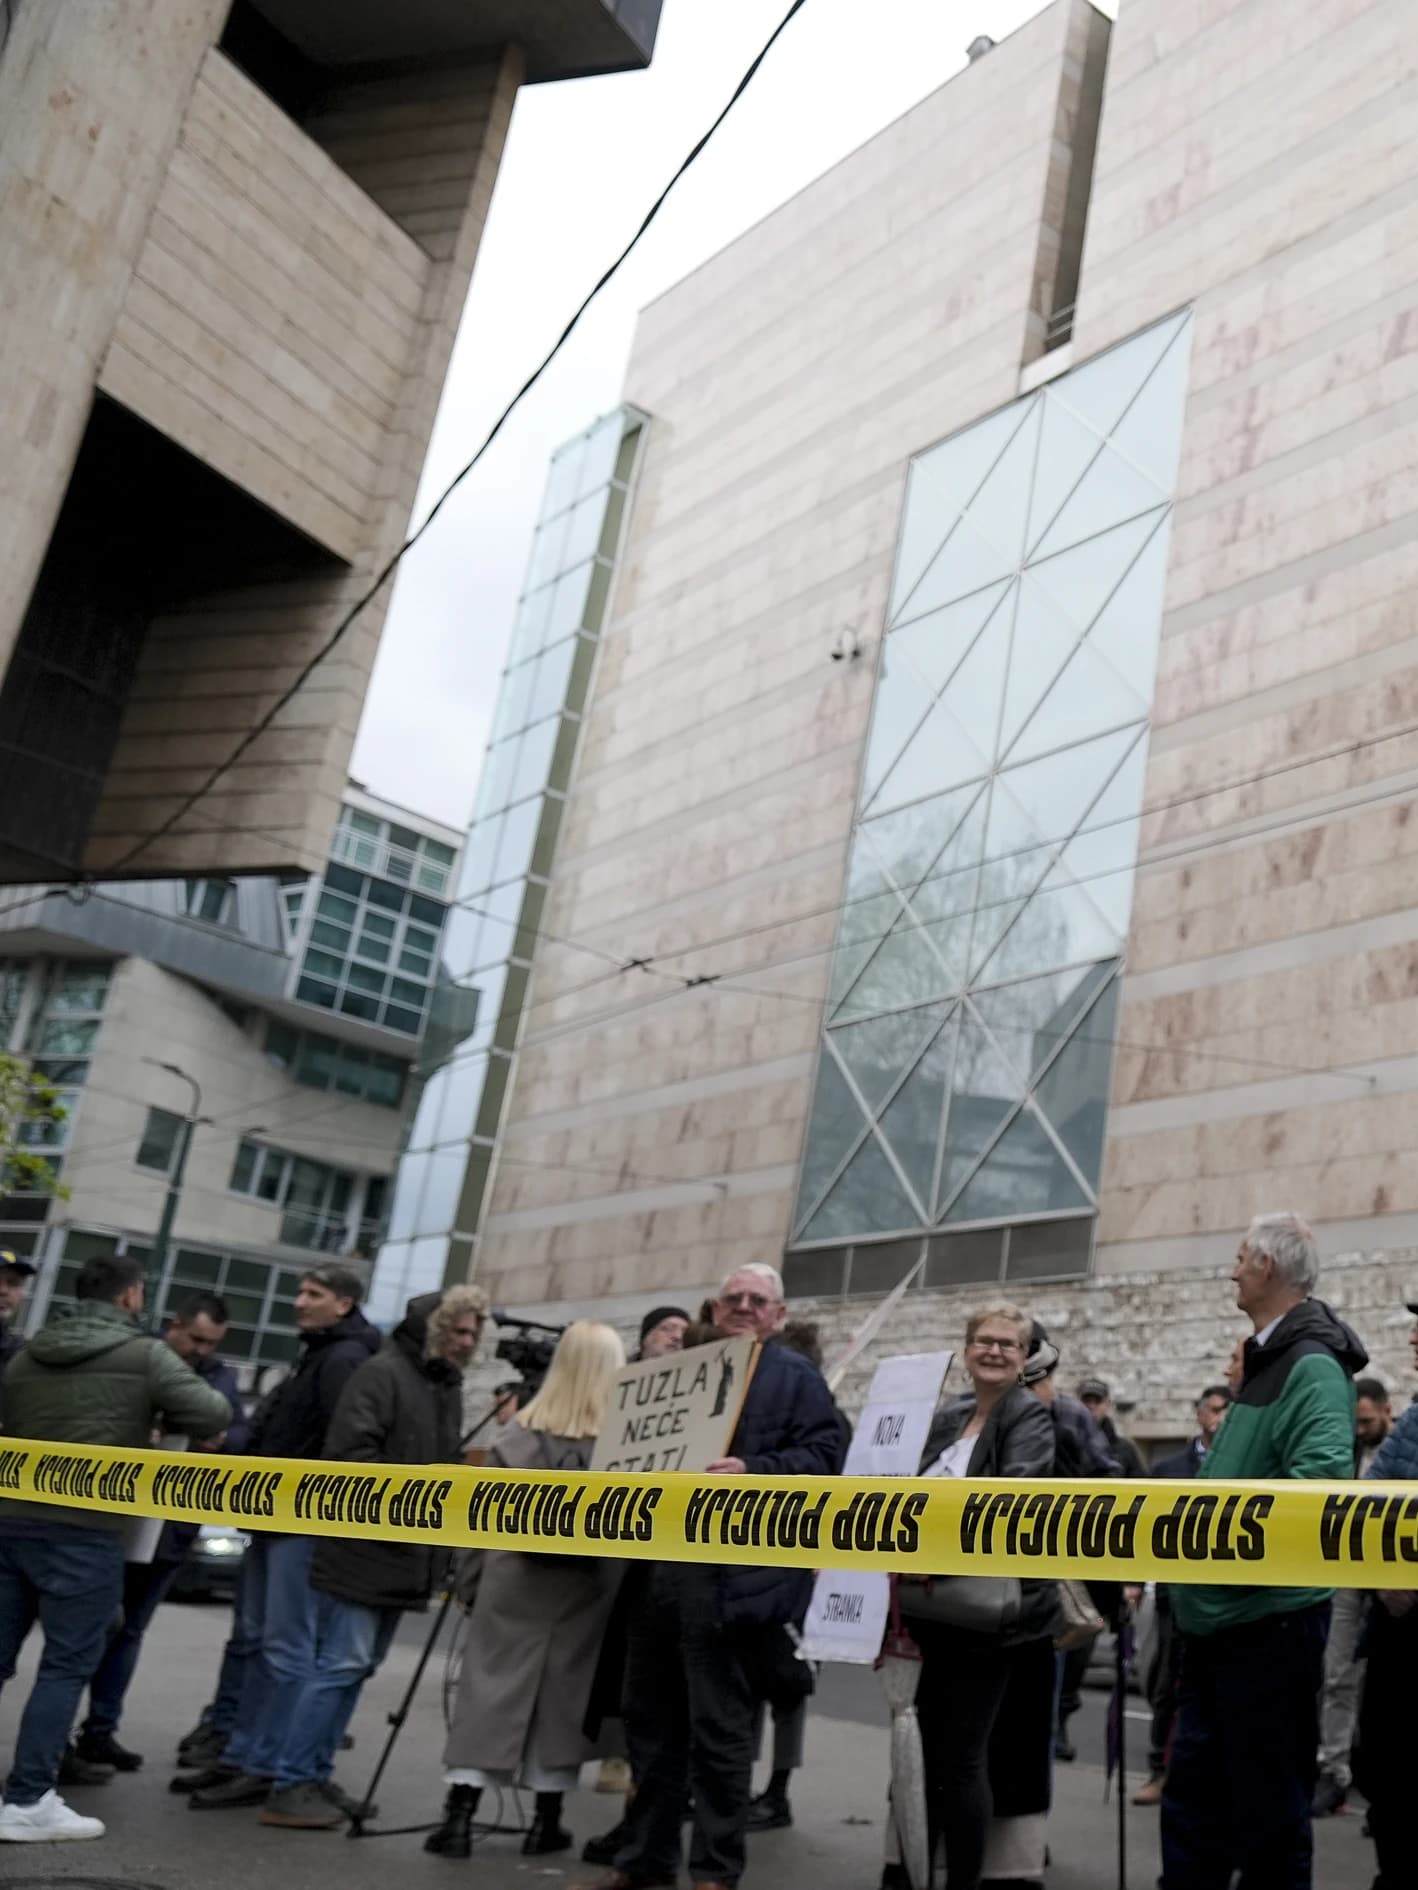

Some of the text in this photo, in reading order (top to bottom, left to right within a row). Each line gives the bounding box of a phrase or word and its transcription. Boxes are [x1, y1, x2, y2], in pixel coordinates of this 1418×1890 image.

[618, 1361, 707, 1411] TUZLA
[872, 1413, 906, 1446] NOVA
[33, 1454, 103, 1499] POLICIJA
[98, 1461, 145, 1503] STOP
[152, 1464, 233, 1512] POLICIJA
[229, 1471, 284, 1517] STOP
[294, 1473, 392, 1525] POLICIJA
[388, 1479, 453, 1530] STOP
[468, 1481, 587, 1538] POLICIJA
[584, 1486, 664, 1542] STOP
[684, 1487, 832, 1550] POLICIJA
[831, 1492, 930, 1553] STOP
[960, 1492, 1146, 1559] POLICIJA
[1151, 1494, 1275, 1561] STOP
